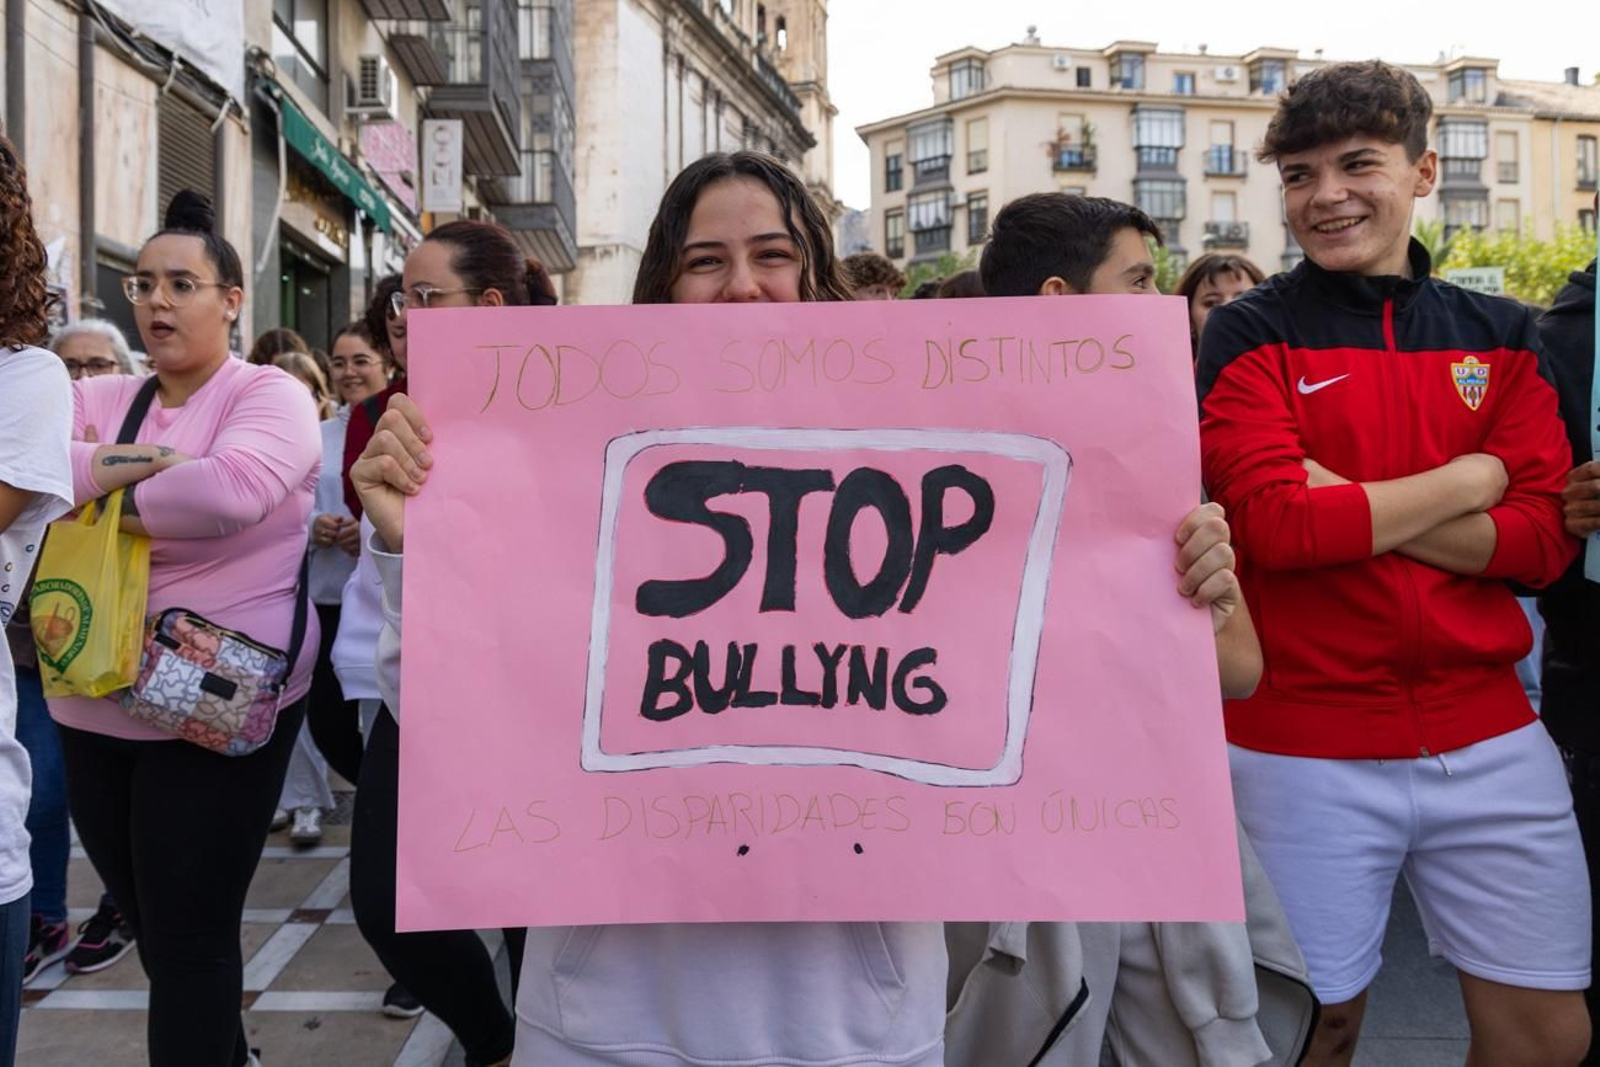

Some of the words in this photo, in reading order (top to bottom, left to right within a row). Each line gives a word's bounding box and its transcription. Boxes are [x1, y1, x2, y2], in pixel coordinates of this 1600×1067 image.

[474, 338, 680, 415] TODOS
[712, 337, 896, 393] SOMOS
[635, 459, 996, 620] STOP
[639, 638, 949, 722] BULLYNG
[453, 799, 561, 853] LAS
[597, 792, 911, 841] DISPARIDADES
[1041, 788, 1181, 835] ÚNICAS
